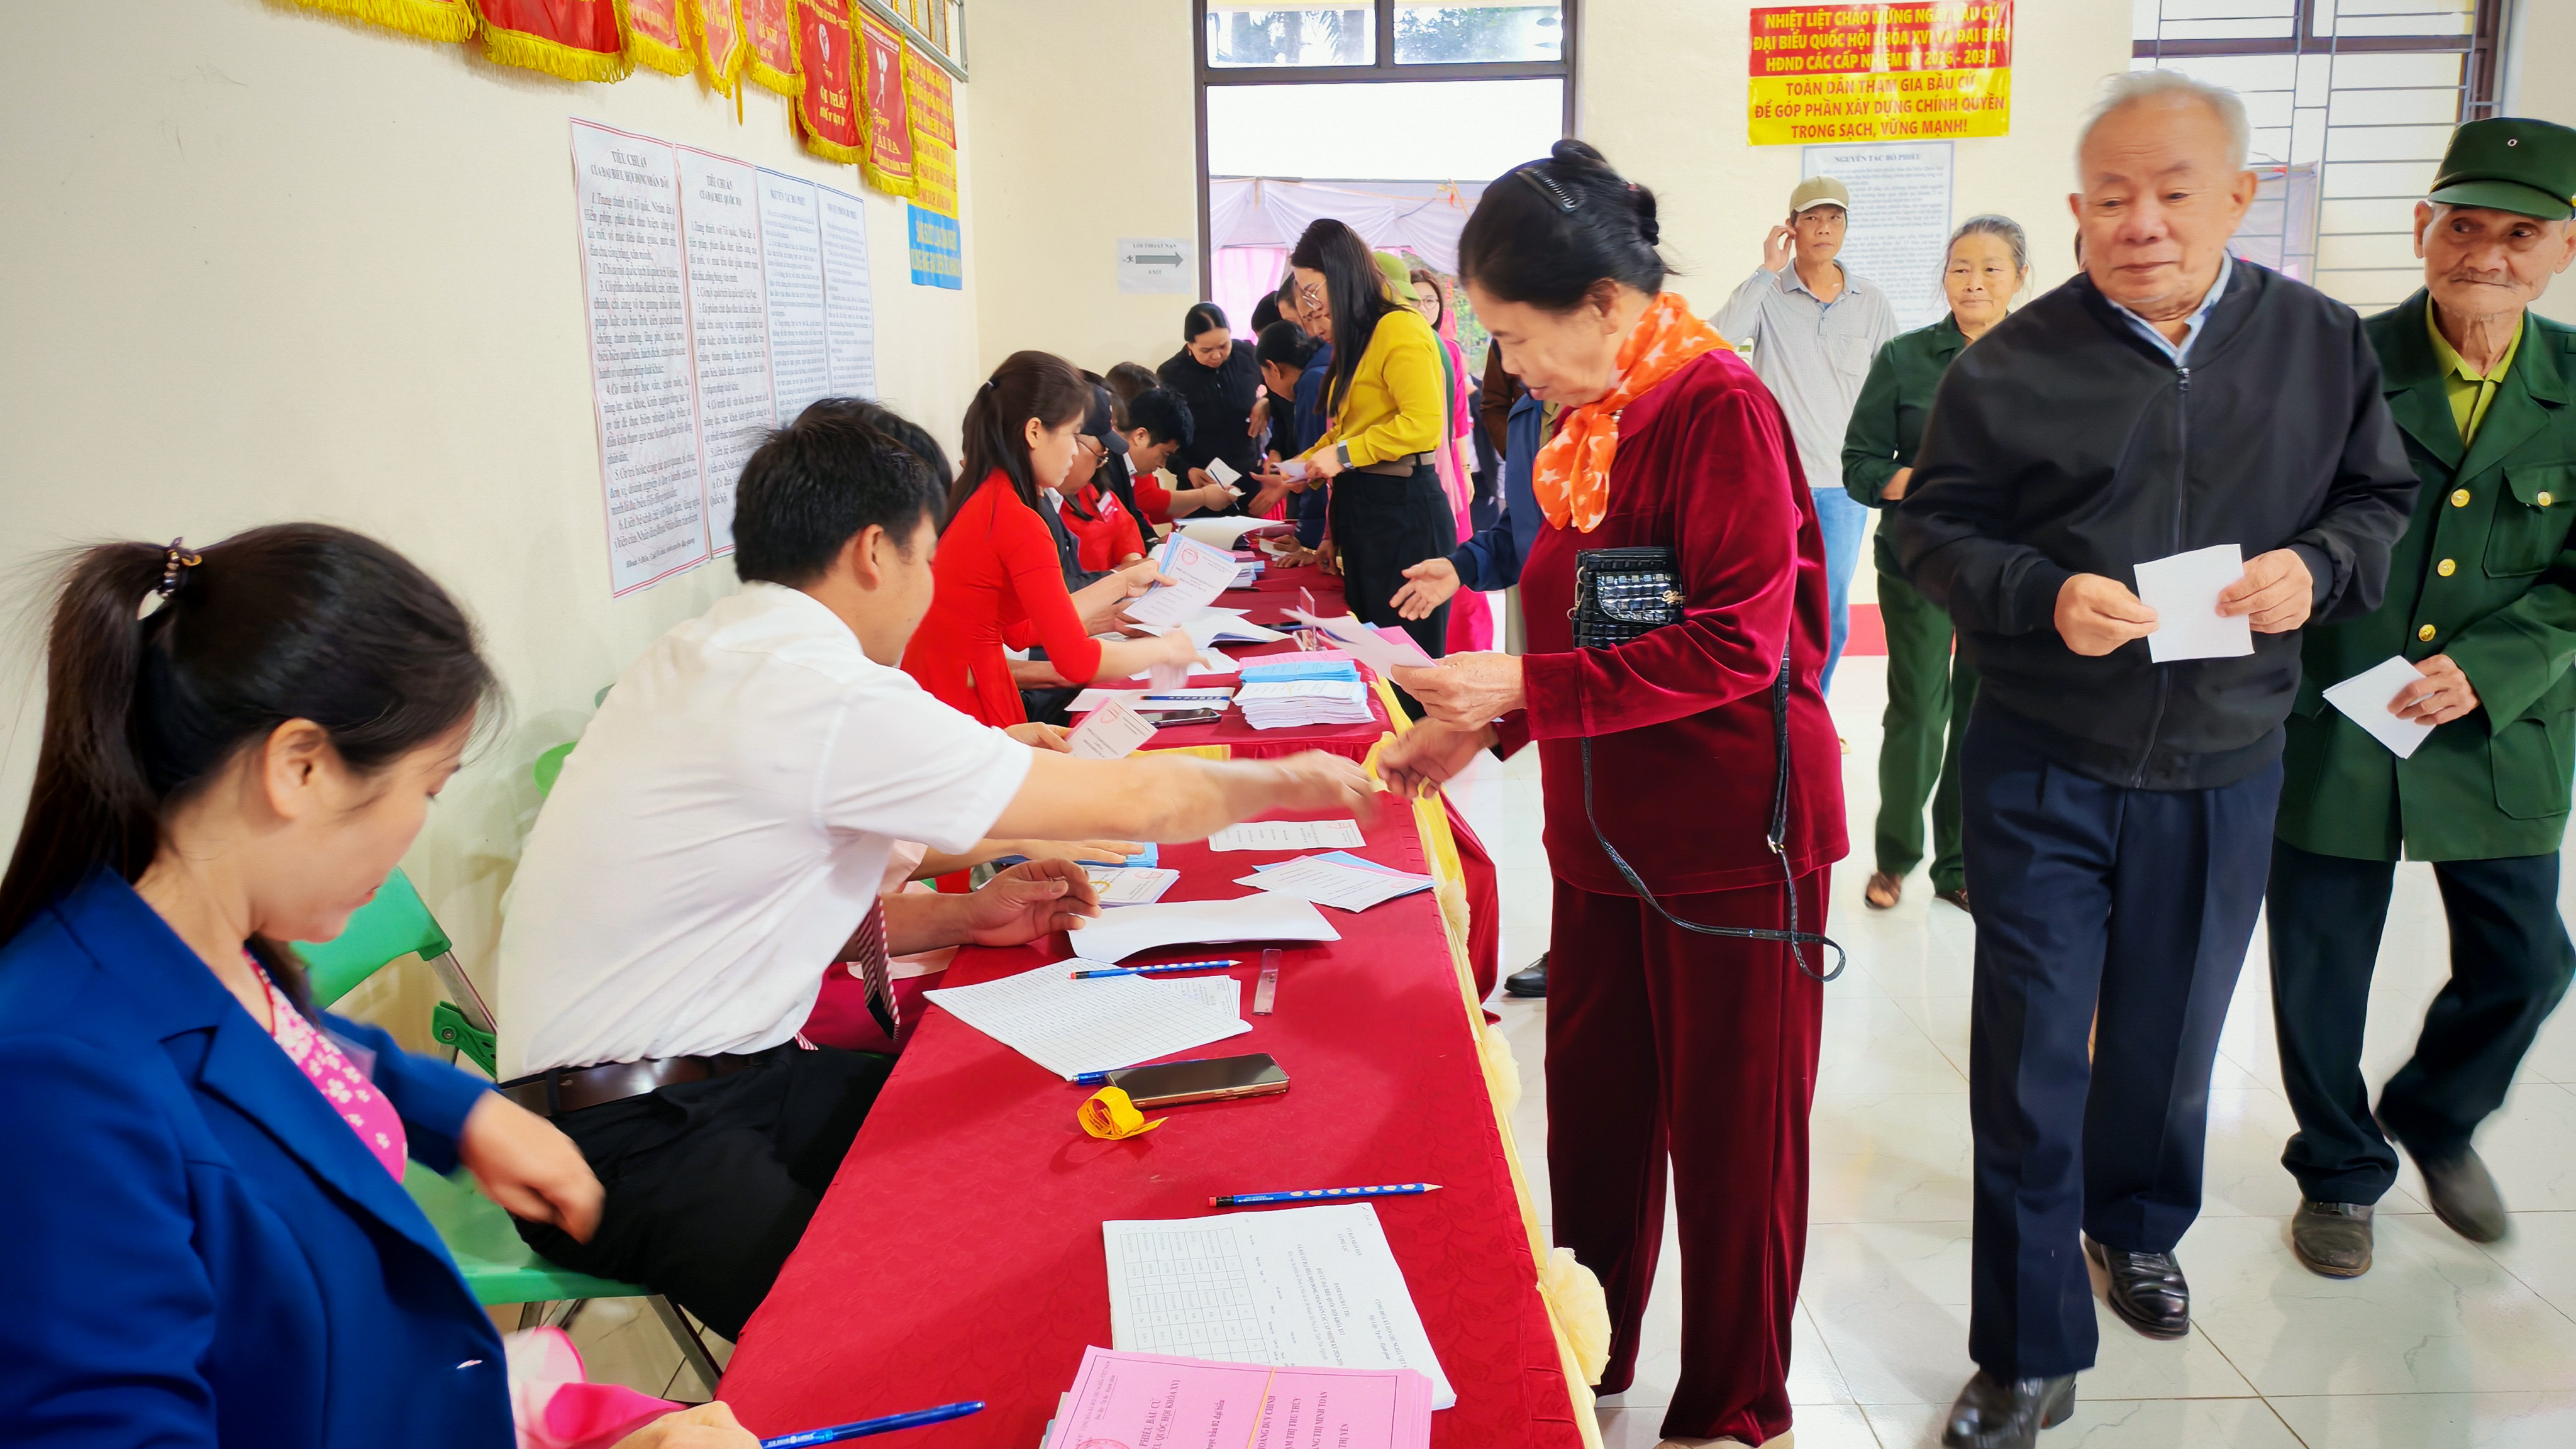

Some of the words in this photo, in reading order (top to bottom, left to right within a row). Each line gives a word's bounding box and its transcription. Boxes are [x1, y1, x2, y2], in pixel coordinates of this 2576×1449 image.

[1765, 9, 1804, 31] NHIỆT
[1806, 8, 1832, 30] LIỆT
[1834, 8, 1869, 26] CHÀO
[1753, 36, 1776, 54] ĐẠI
[1779, 29, 1807, 50] BIỂU
[1809, 28, 1845, 50] QUỐC
[1846, 28, 1870, 50] HỘI
[1873, 27, 1909, 46] KHÓA
[1911, 30, 1932, 45] XVI
[1957, 28, 1979, 47] ĐẠI
[1982, 22, 2007, 43] BIỂU
[1766, 56, 1804, 72] HĐND
[1806, 51, 1831, 70] CÁC
[1833, 49, 1858, 69] CẤP
[1924, 51, 1954, 66] 2026
[1963, 49, 1996, 64] 2031!
[1786, 78, 1823, 96] TOÀN
[1826, 77, 1855, 94] DÂN
[1858, 79, 1897, 94] THAM
[1901, 78, 1923, 92] GIA
[1928, 72, 1954, 91] BẦU
[1958, 71, 1975, 89] CỬ
[1755, 99, 1772, 119] ĐỂ
[1775, 100, 1802, 118] GÓP
[1806, 98, 1842, 117] PHẦN
[1845, 97, 1870, 116] XÂY
[1874, 99, 1912, 118] DỰNG
[1916, 95, 1958, 113] CHÍNH
[1962, 92, 2005, 113] QUYỀN
[1791, 124, 1836, 139] TRONG
[1839, 123, 1877, 141] SẠCH,
[1880, 118, 1918, 136] VỮNG
[1922, 119, 1968, 137] MẠNH!
[1170, 1380, 1180, 1390] XVI
[1150, 1397, 1161, 1409] CỬ
[1165, 1391, 1177, 1408] KHÓA
[1145, 1411, 1157, 1424] BẦU
[1161, 1410, 1172, 1421] HỘI
[1262, 1416, 1272, 1428] DUY
[1288, 1414, 1298, 1426] THU
[1315, 1409, 1325, 1424] MINH
[1138, 1426, 1153, 1446] PHIẾU
[1155, 1424, 1167, 1440] QUỐC
[1286, 1428, 1297, 1439] THỊ
[1313, 1426, 1324, 1437] THỊ
[1338, 1424, 1348, 1435] YẾN
[1338, 1437, 1349, 1448] THỊ
